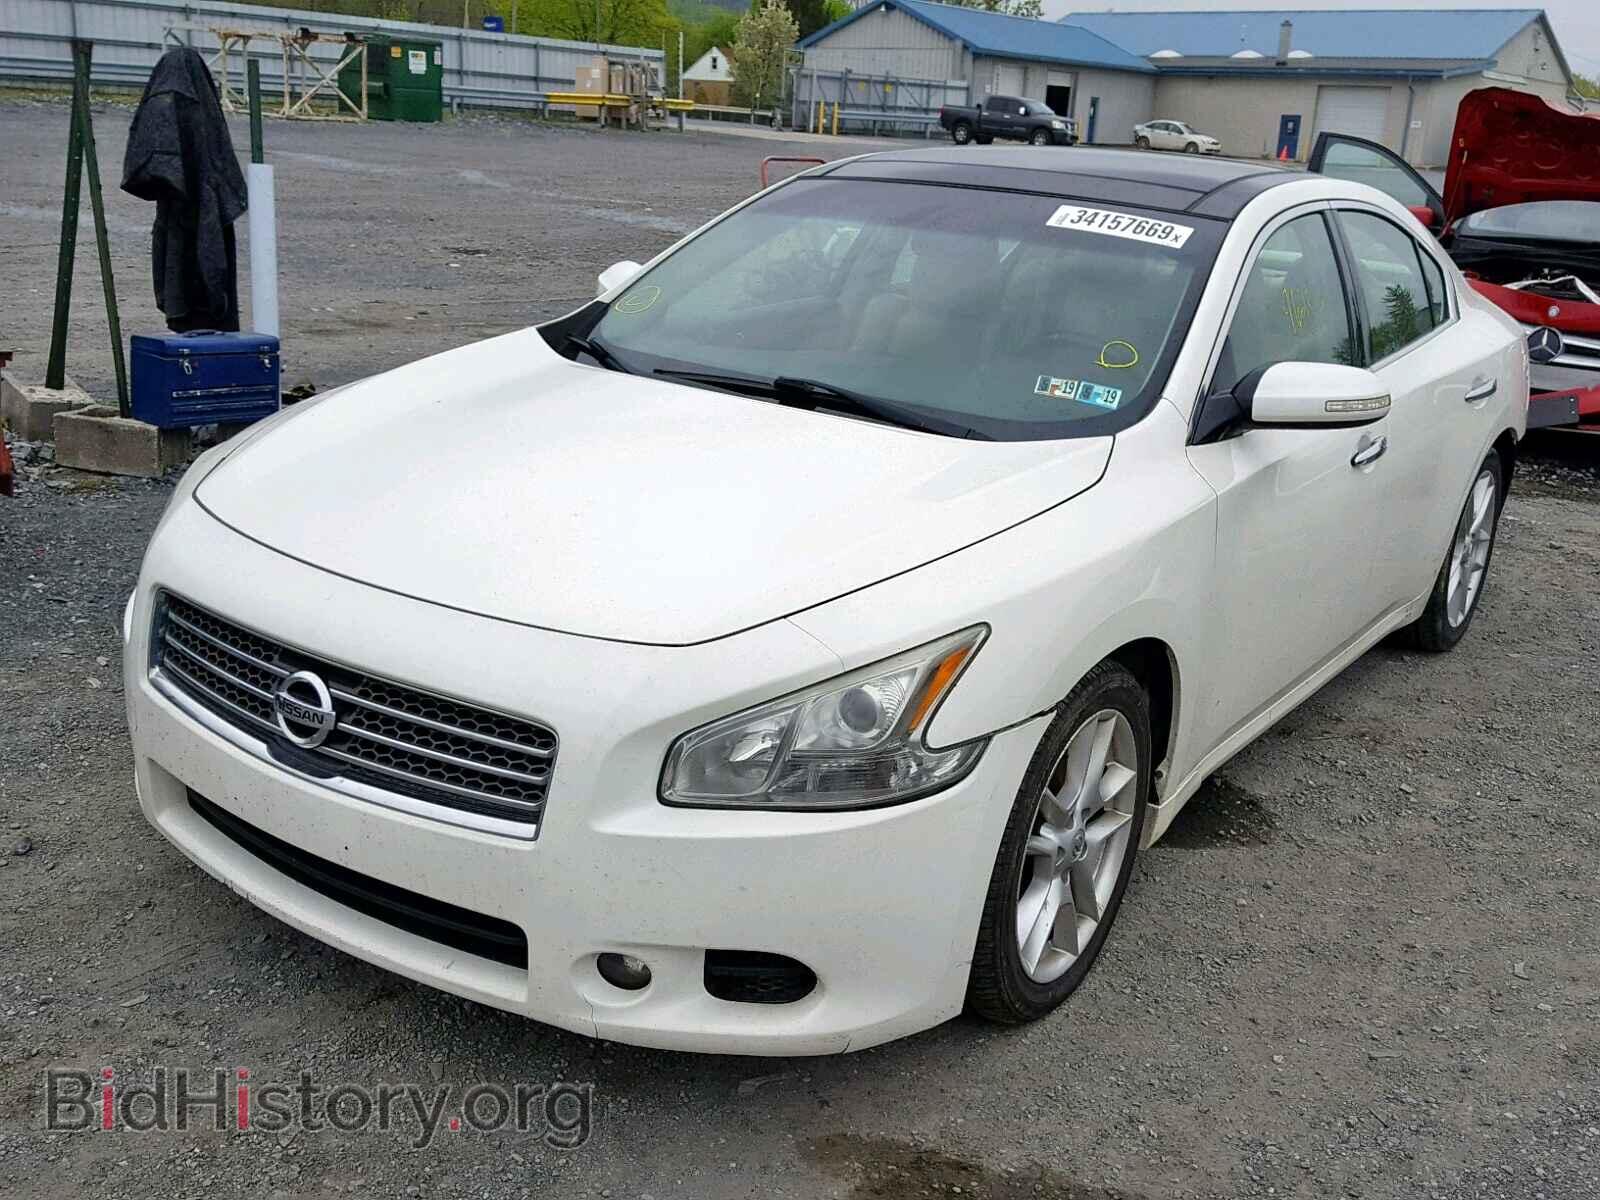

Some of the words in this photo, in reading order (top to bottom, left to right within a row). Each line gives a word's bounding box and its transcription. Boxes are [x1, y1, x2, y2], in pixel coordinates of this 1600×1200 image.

[1062, 381, 1075, 394] 19
[1104, 389, 1118, 404] 19
[276, 694, 324, 724] NISSAN
